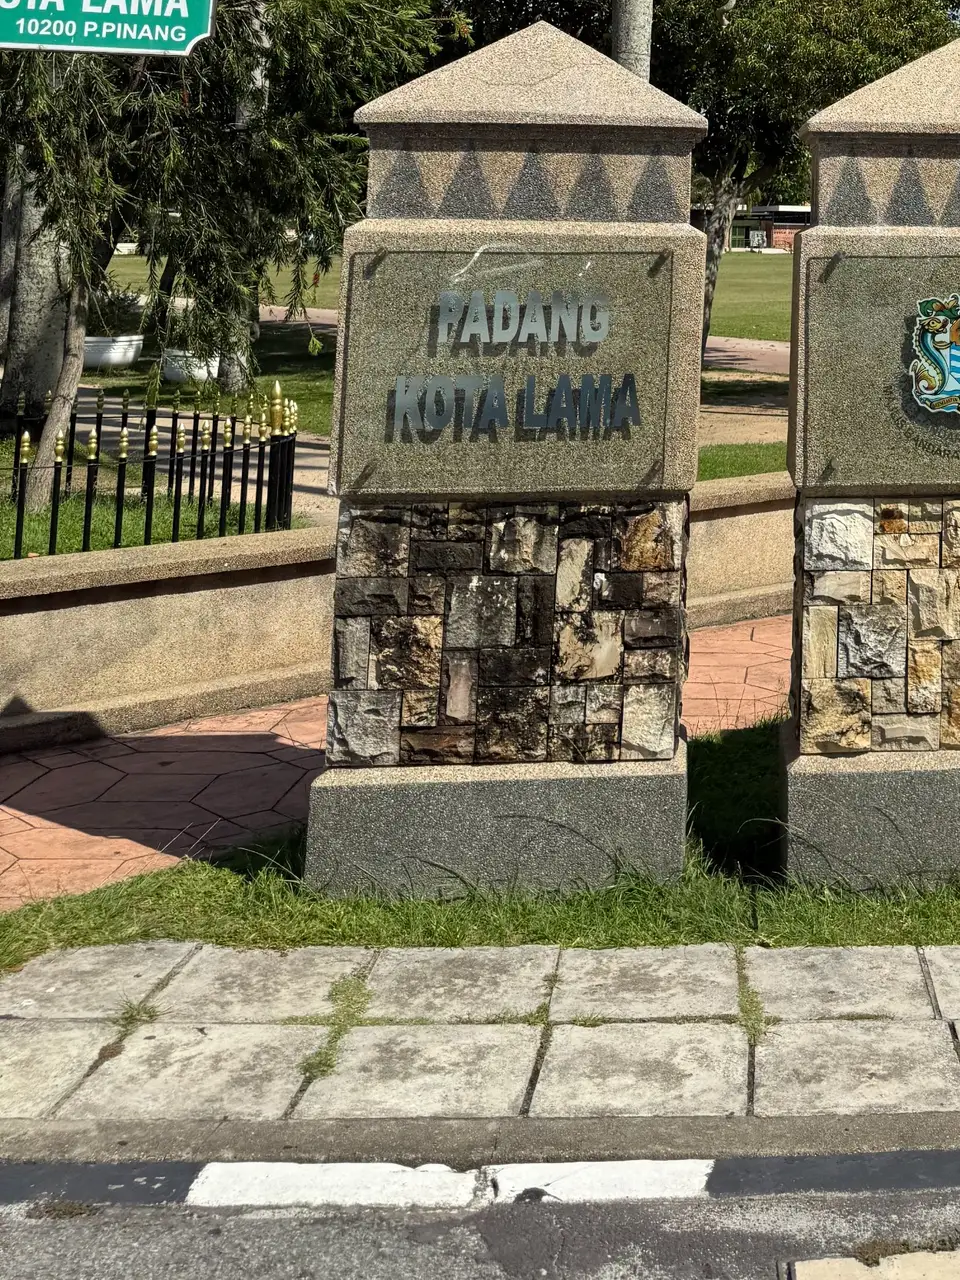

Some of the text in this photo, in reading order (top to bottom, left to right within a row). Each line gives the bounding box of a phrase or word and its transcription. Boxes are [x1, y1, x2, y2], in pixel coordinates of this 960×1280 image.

[16, 18, 187, 42] 10200 P.PINANG
[437, 290, 609, 343] PADANG
[393, 373, 642, 429] KOTA LAMA
